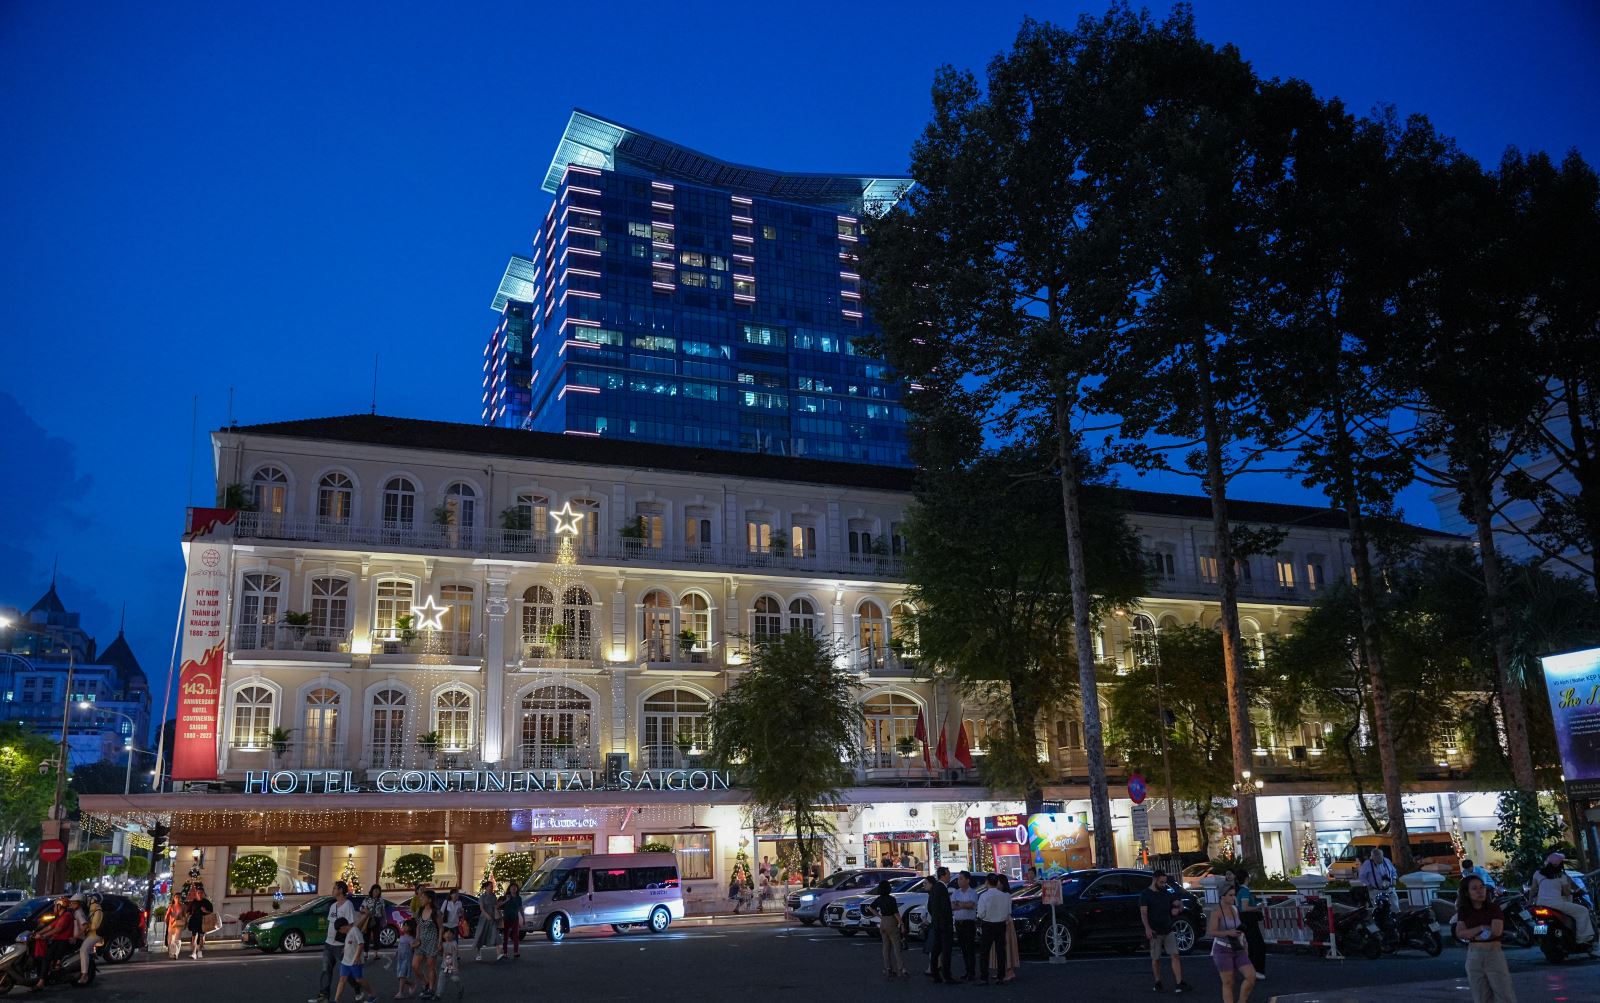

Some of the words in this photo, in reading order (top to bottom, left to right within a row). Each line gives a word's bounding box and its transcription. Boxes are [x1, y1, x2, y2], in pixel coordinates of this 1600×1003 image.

[183, 682, 205, 695] 143
[245, 770, 360, 794] HOTEL
[376, 770, 605, 794] CONTINENTAL
[618, 770, 730, 791] SAIGON
